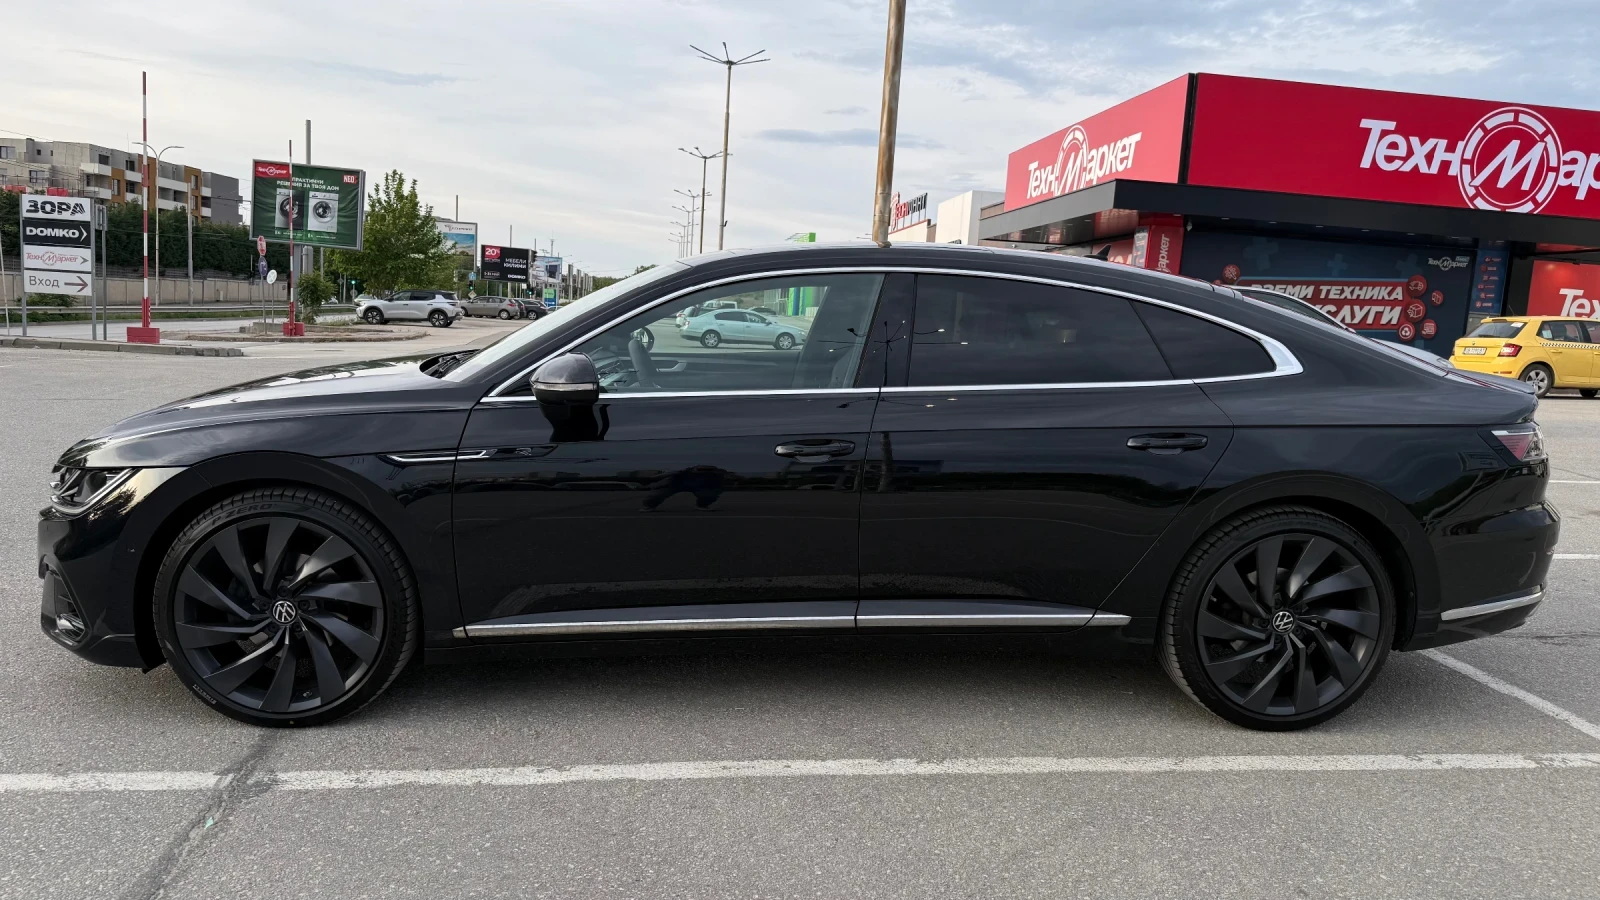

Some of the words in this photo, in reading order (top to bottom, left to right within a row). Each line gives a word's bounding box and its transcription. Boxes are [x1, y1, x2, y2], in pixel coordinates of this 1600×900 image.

[26, 200, 86, 216] ЗОРА
[26, 227, 79, 238] DOMKO
[28, 275, 60, 289] Вход
[1319, 285, 1403, 301] ТЕХНИКА
[1314, 303, 1402, 325] СЛУГИ
